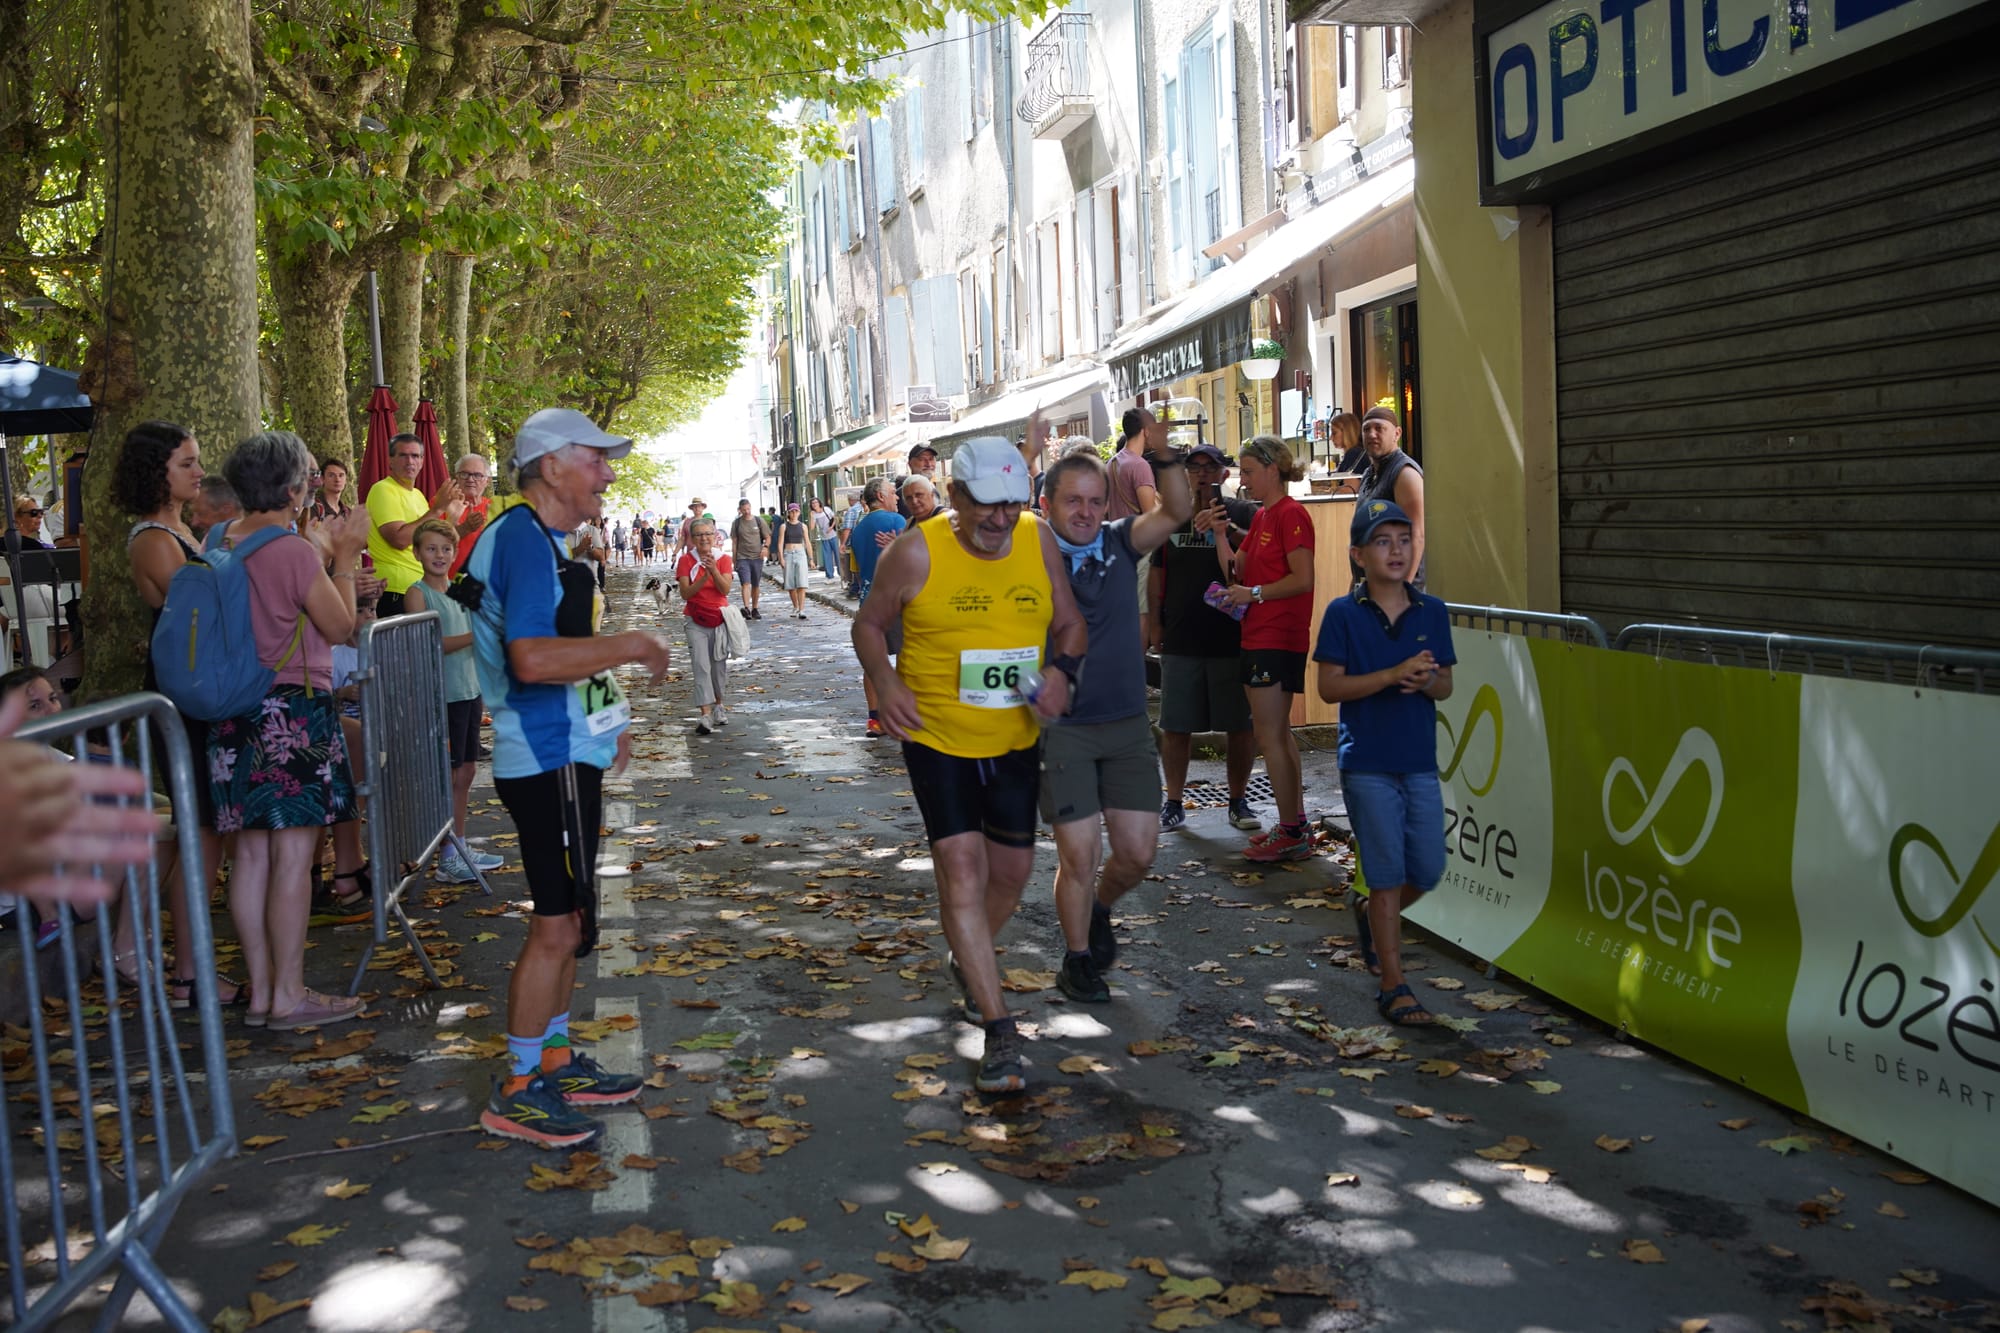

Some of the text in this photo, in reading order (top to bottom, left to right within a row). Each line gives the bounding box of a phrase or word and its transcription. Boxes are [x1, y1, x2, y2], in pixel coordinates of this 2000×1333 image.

[1179, 339, 1203, 370] VAL
[983, 665, 1020, 689] 66
[1583, 849, 1742, 969] lozère
[1575, 928, 1724, 1004] LE DÉPARTEMENT
[1827, 1035, 1856, 1065] LE
